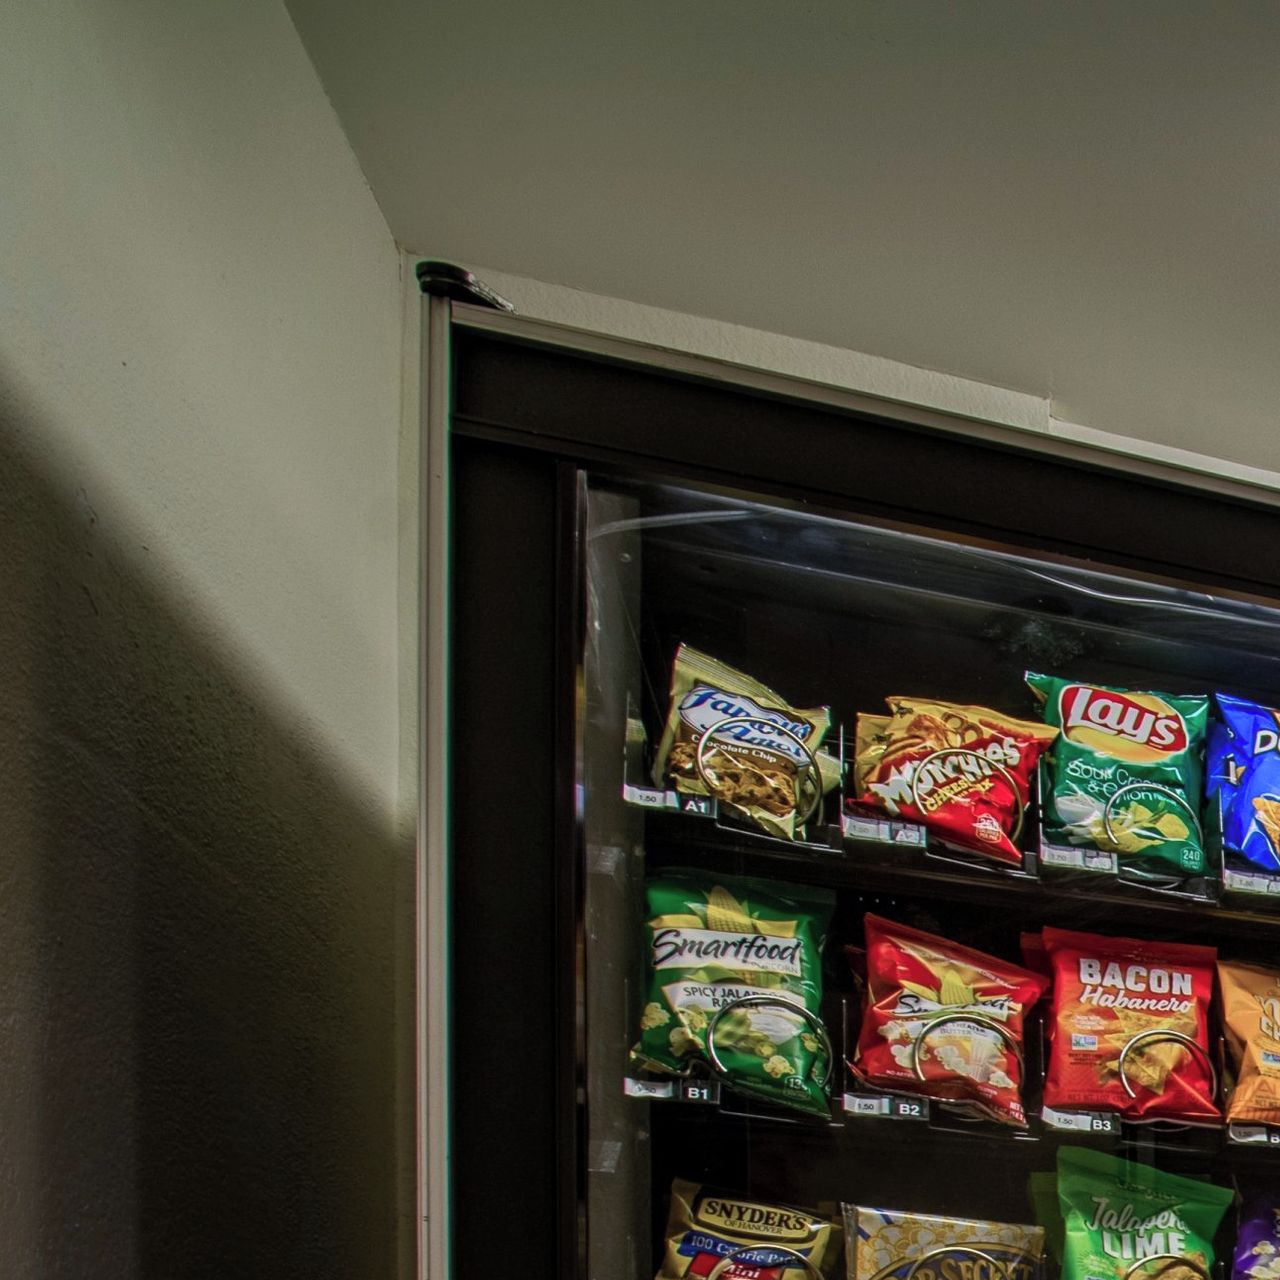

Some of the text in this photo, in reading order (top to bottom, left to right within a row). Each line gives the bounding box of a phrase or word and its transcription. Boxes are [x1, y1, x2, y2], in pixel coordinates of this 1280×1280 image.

[683, 689, 811, 741] Famous
[1067, 687, 1180, 747] Lay's
[751, 749, 777, 763] Chip
[685, 800, 708, 813] A1
[1183, 849, 1201, 862] 240
[652, 929, 800, 967] Smartfood
[1079, 958, 1194, 996] BACON
[683, 986, 717, 998] SPICY
[1080, 985, 1194, 1014] Habanero
[687, 1087, 708, 1100] B1
[899, 1103, 921, 1116] B2
[1092, 1119, 1112, 1131] B3
[704, 1200, 808, 1232] SNYDER'S
[723, 1218, 784, 1235] OF HANOVER
[691, 1234, 713, 1249] 100
[1101, 1230, 1187, 1260] LIME
[723, 1264, 761, 1280] Mini
